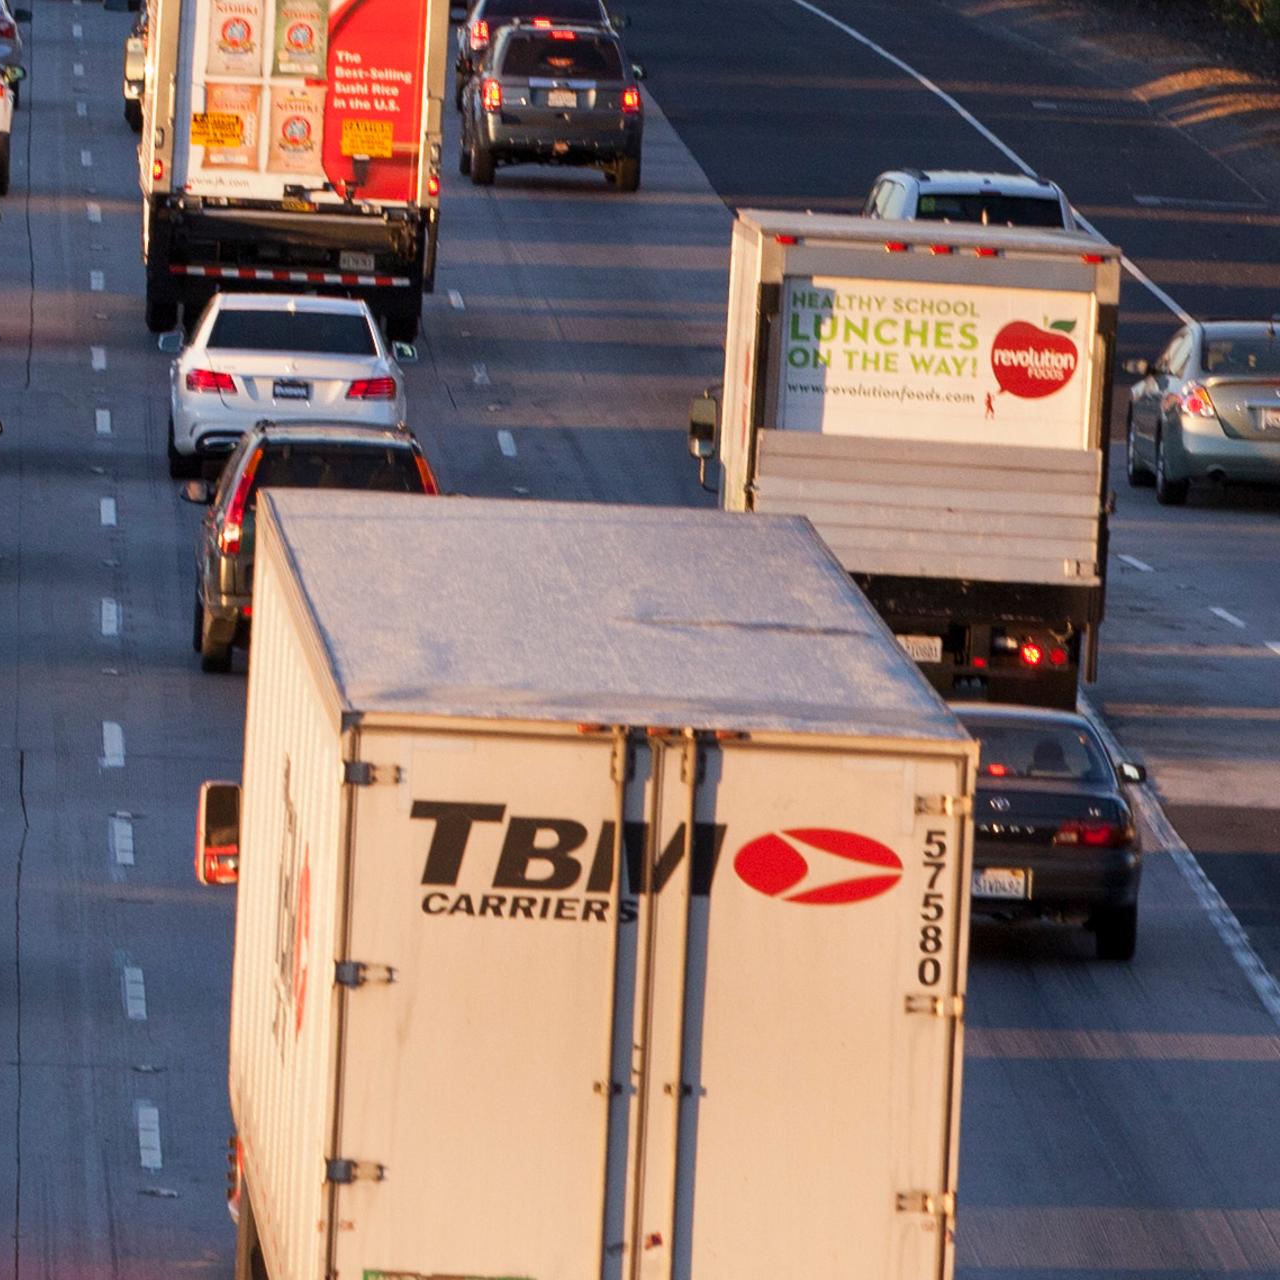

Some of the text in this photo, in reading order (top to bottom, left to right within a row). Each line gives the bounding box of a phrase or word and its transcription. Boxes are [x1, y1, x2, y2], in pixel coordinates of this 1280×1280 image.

[336, 50, 361, 65] The
[335, 67, 412, 85] Best-Selling
[334, 80, 400, 97] Sushi Rice
[333, 97, 400, 112] in the U.S.
[792, 291, 980, 318] HEALTHY SCHOOL
[791, 314, 979, 351] LUNCHES
[789, 347, 979, 378] ON THE WAY!
[993, 346, 1075, 370] revolution
[1027, 367, 1065, 381] FOODS
[786, 383, 976, 405] www.revolutionfoods.com
[410, 800, 728, 896] TBM
[420, 892, 639, 925] CARRIERS
[917, 829, 948, 987] 57580
